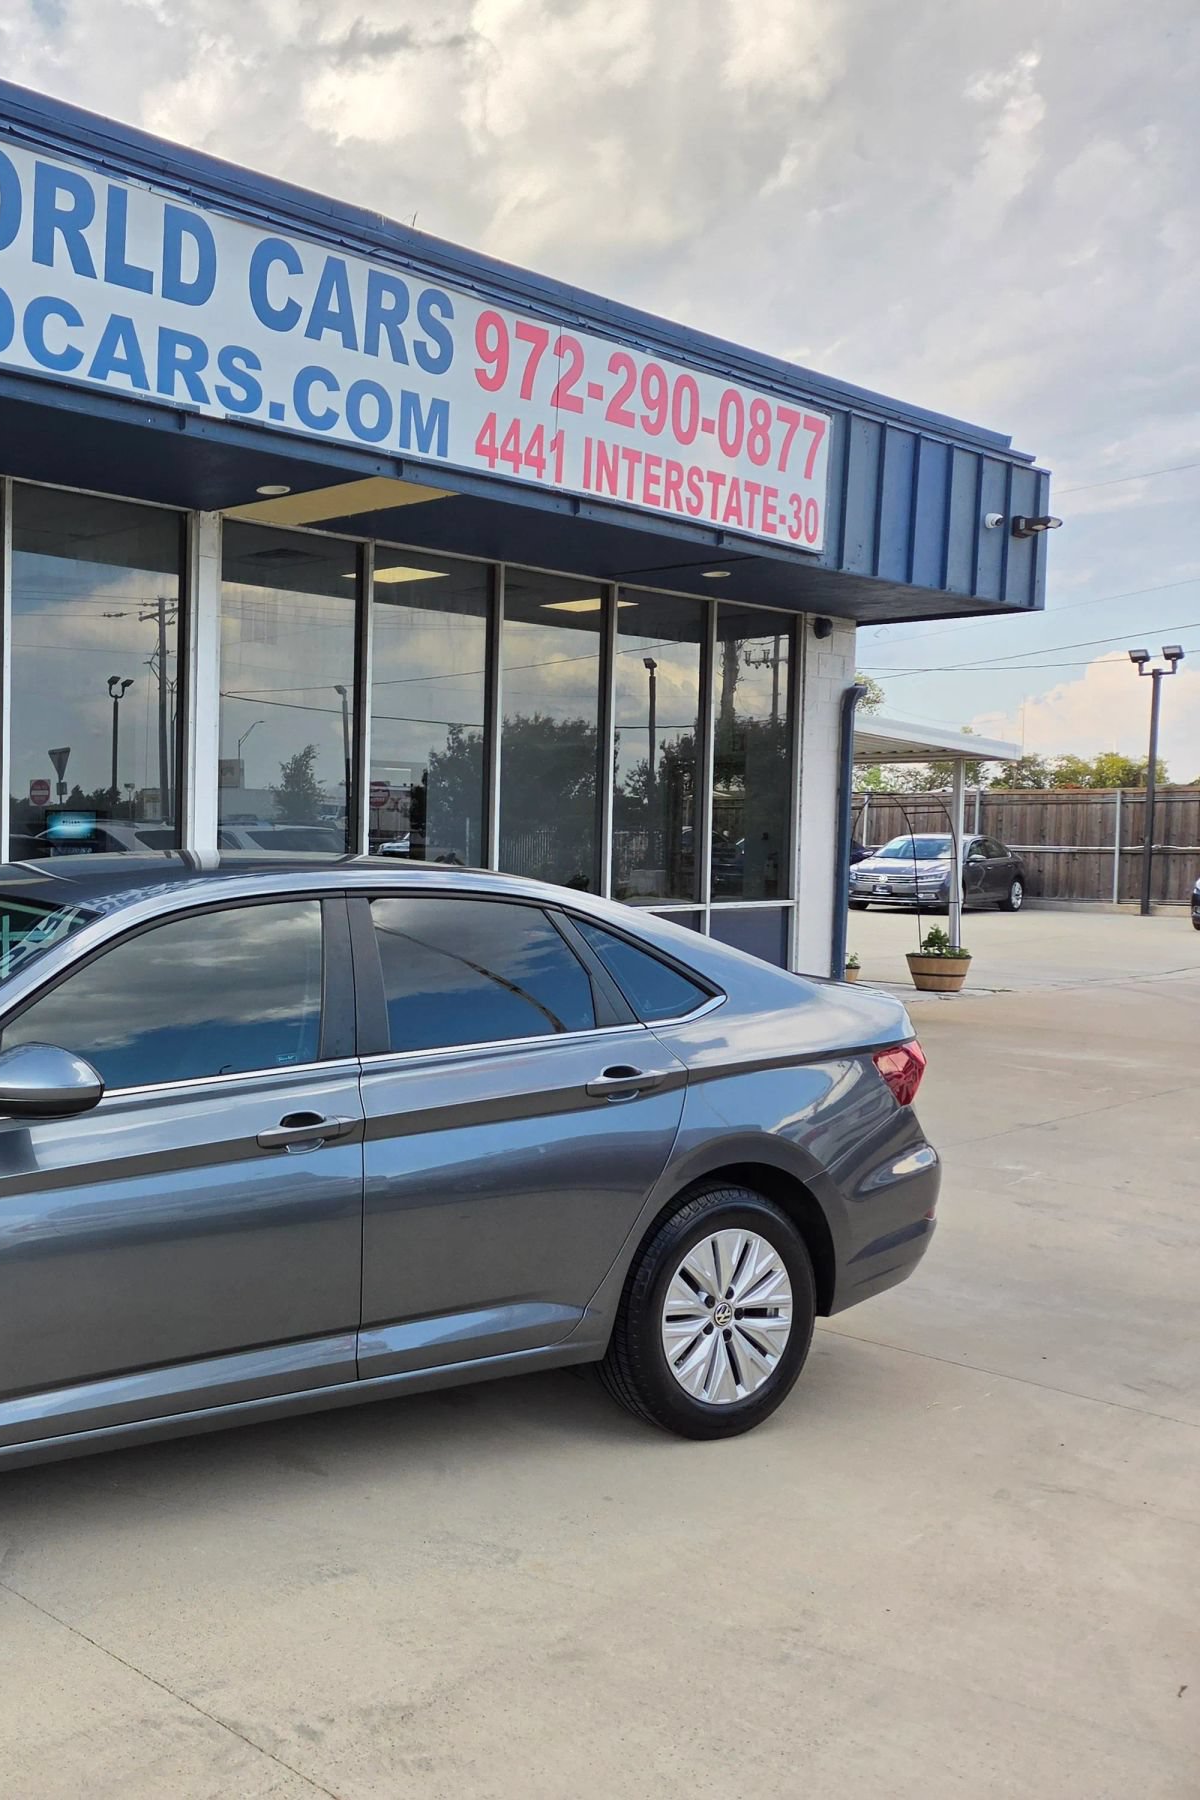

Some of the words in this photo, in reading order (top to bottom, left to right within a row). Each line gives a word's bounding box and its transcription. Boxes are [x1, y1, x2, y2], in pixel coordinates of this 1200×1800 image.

[249, 237, 455, 375] CARS
[474, 310, 826, 480] 972-290-0877
[475, 411, 566, 484] 4441
[583, 436, 820, 544] INTERSTATE-30
